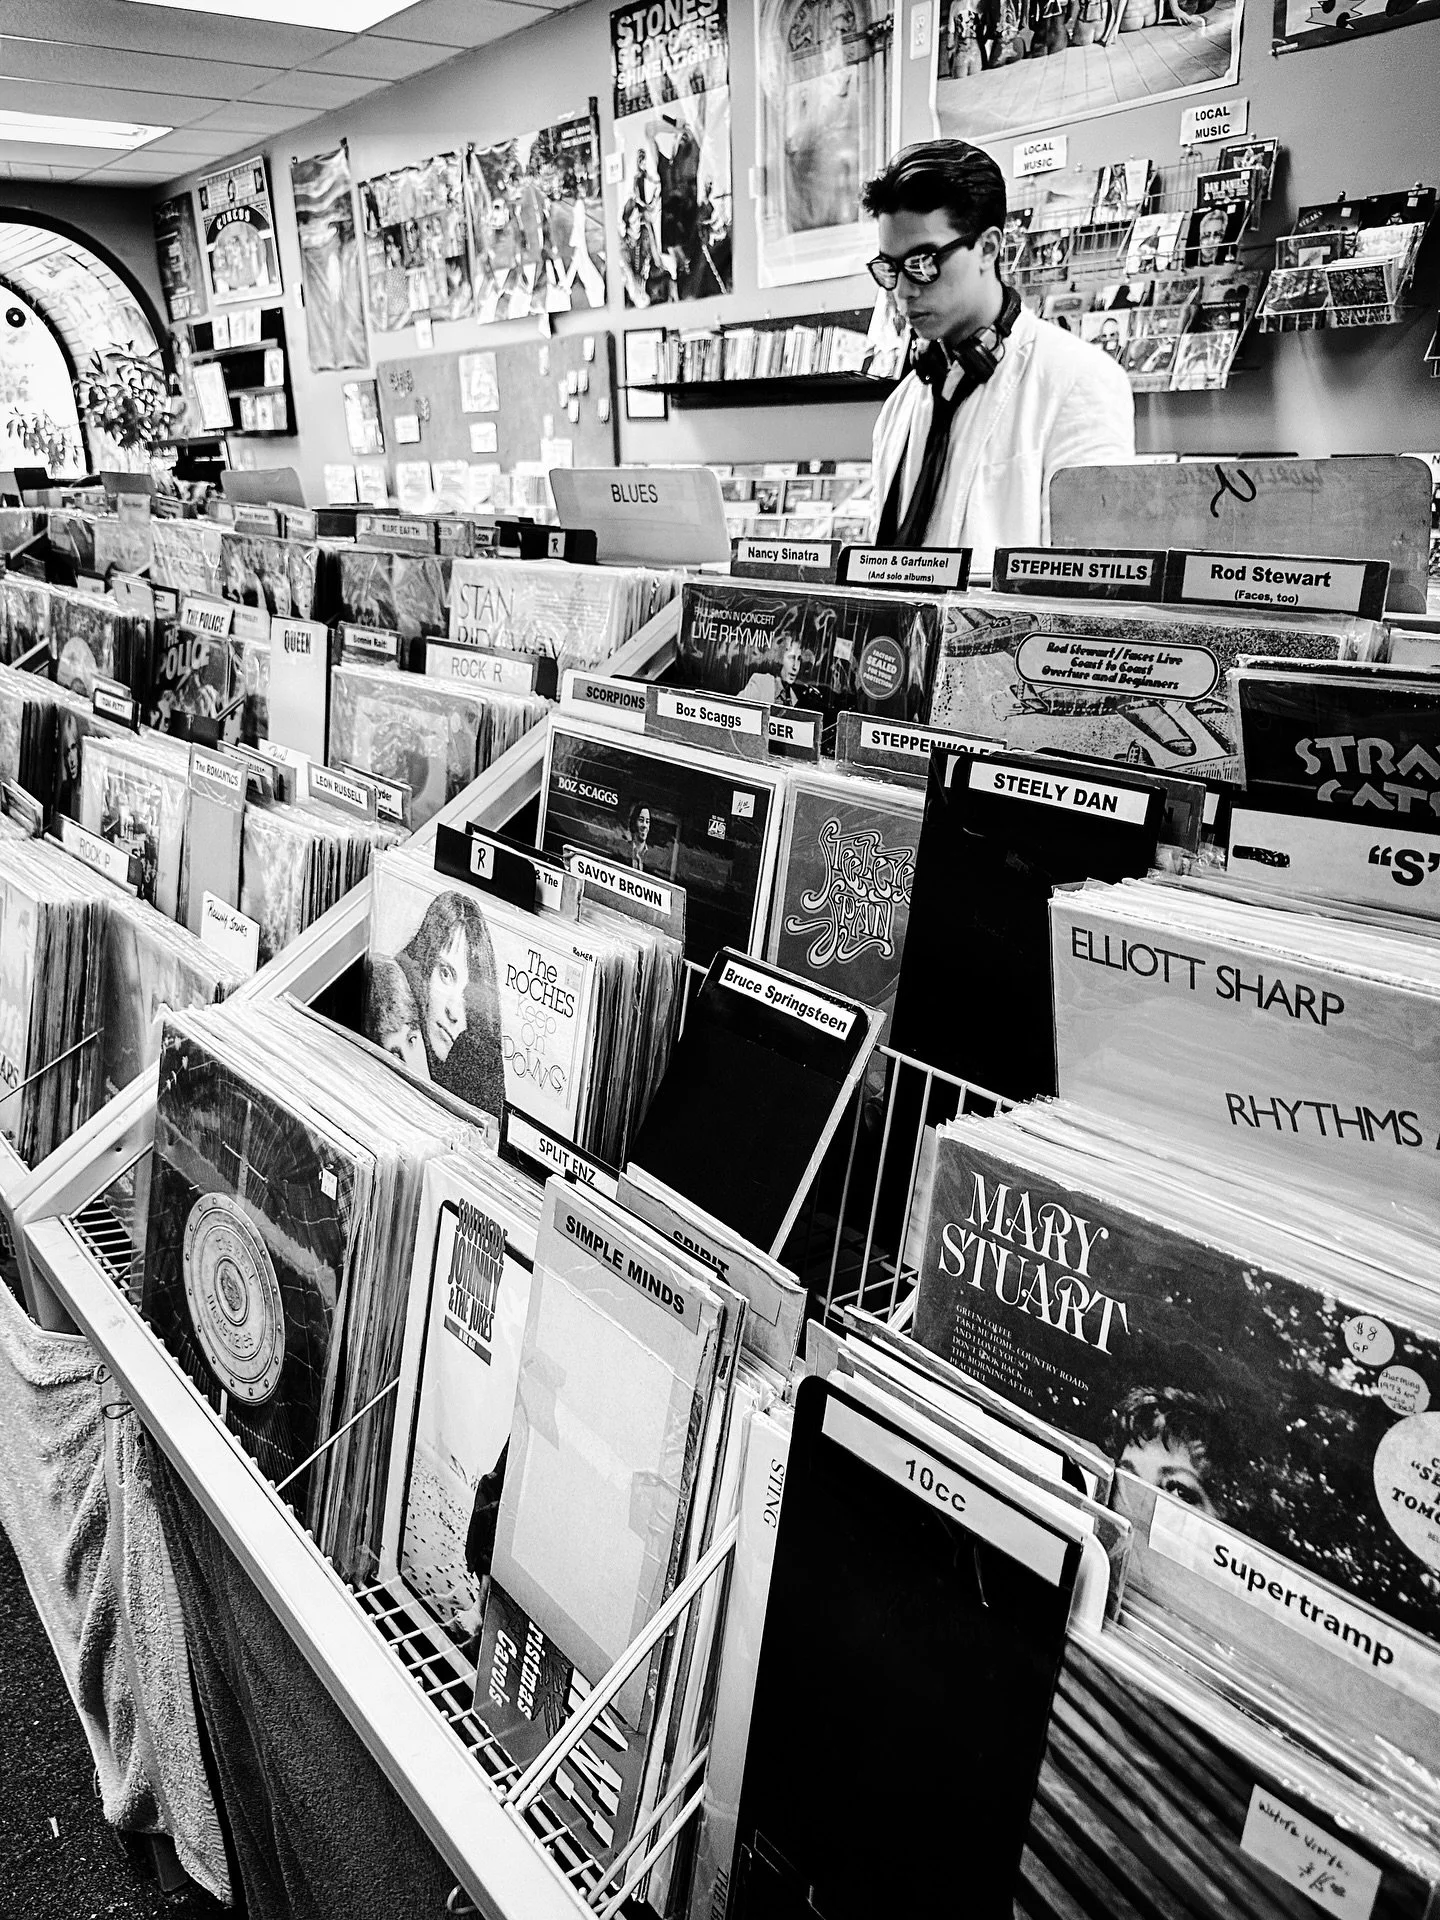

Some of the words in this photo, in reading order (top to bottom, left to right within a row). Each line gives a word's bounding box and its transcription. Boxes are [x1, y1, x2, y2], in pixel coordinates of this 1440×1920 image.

[616, 0, 719, 47] STONES
[1194, 106, 1231, 121] LOCAL
[1194, 123, 1231, 139] MUSIC
[1023, 142, 1055, 156] LOCAL
[1023, 157, 1054, 171] MUSIC
[216, 208, 251, 231] CIRCUS
[610, 483, 659, 504] BLUES
[747, 546, 783, 561] Nancy
[784, 546, 820, 561] Sinatra
[859, 554, 887, 567] Simon
[890, 556, 899, 567] &
[900, 557, 950, 569] Garfunkel
[867, 570, 886, 582] (And
[886, 571, 902, 582] solo
[903, 571, 936, 584] albums)
[1009, 558, 1085, 579] STEPHEN
[1088, 562, 1149, 582] STILLS
[1210, 564, 1247, 582] Rod
[1252, 566, 1332, 588] Stewart
[458, 583, 515, 625] STAN
[1234, 589, 1274, 604] (Faces,
[1276, 592, 1299, 605] too)
[186, 609, 199, 626] THE
[200, 612, 225, 633] POLICE
[691, 620, 718, 642] LIVE
[709, 609, 732, 621] SIMON
[733, 611, 740, 621] IN
[741, 612, 776, 626] CONCERT
[284, 628, 312, 655] QUEEN
[1046, 641, 1069, 654] Rod
[1156, 652, 1183, 666] Live
[451, 656, 489, 679] ROCK
[493, 662, 503, 682] R
[866, 655, 898, 674] SEALED
[1041, 665, 1090, 680] Overture
[1092, 672, 1117, 683] and
[1118, 673, 1180, 690] Beginners
[1071, 657, 1103, 669] Coast
[1106, 660, 1117, 672] to
[1118, 662, 1153, 676] Coast
[586, 686, 645, 710] SCORPIONS
[676, 702, 695, 719] Boz
[696, 706, 742, 728] Scaggs
[1295, 736, 1440, 780] STRA
[195, 760, 206, 773] The
[206, 763, 239, 787] ROMANTICS
[315, 774, 333, 791] LEON
[334, 782, 363, 805] RUSSELL
[374, 785, 392, 801] yder
[558, 776, 577, 793] BOZ
[578, 782, 619, 807] SCAGGS
[993, 773, 1068, 802] STEELY
[1073, 791, 1119, 814] DAN
[79, 837, 102, 866] ROCK
[477, 847, 486, 870] R
[544, 872, 559, 887] The
[577, 860, 617, 890] SAVOY
[619, 878, 662, 908] BROWN
[528, 948, 558, 984] The
[1071, 926, 1206, 990] ELLIOTT
[1215, 964, 1345, 1026] SHARP
[505, 963, 575, 1019] ROCHES
[723, 968, 763, 995] Bruce
[764, 985, 849, 1033] Springsteen
[1225, 1093, 1423, 1147] RHYTHMS
[538, 1137, 572, 1172] SPLIT
[573, 1158, 596, 1187] ENZ
[455, 1198, 508, 1267] SOUTHSIDE
[965, 1171, 1110, 1279] MARY
[448, 1231, 504, 1314] JOHNNY
[565, 1214, 624, 1272] SIMPLE
[627, 1253, 685, 1315] MINDS
[938, 1222, 1131, 1356] STUART
[454, 1283, 471, 1323] THE
[468, 1296, 495, 1343] JUKES
[956, 1304, 983, 1324] GREEN
[954, 1326, 972, 1341] AND
[977, 1337, 998, 1354] LOVE
[999, 1349, 1017, 1367] YOU
[1017, 1359, 1029, 1371] SO
[955, 1315, 977, 1330] TAKE
[977, 1324, 989, 1337] ME
[1017, 1347, 1058, 1376] COUNTRY
[1059, 1370, 1090, 1391] ROADS
[951, 1346, 967, 1360] THE
[967, 1354, 1007, 1383] MORNING
[1007, 1378, 1035, 1398] AFTER
[1001, 1362, 1024, 1380] BACK
[763, 1458, 787, 1529] STING
[904, 1458, 967, 1514] 10cc
[1212, 1543, 1395, 1668] Supertramp
[489, 1629, 518, 1708] Carols
